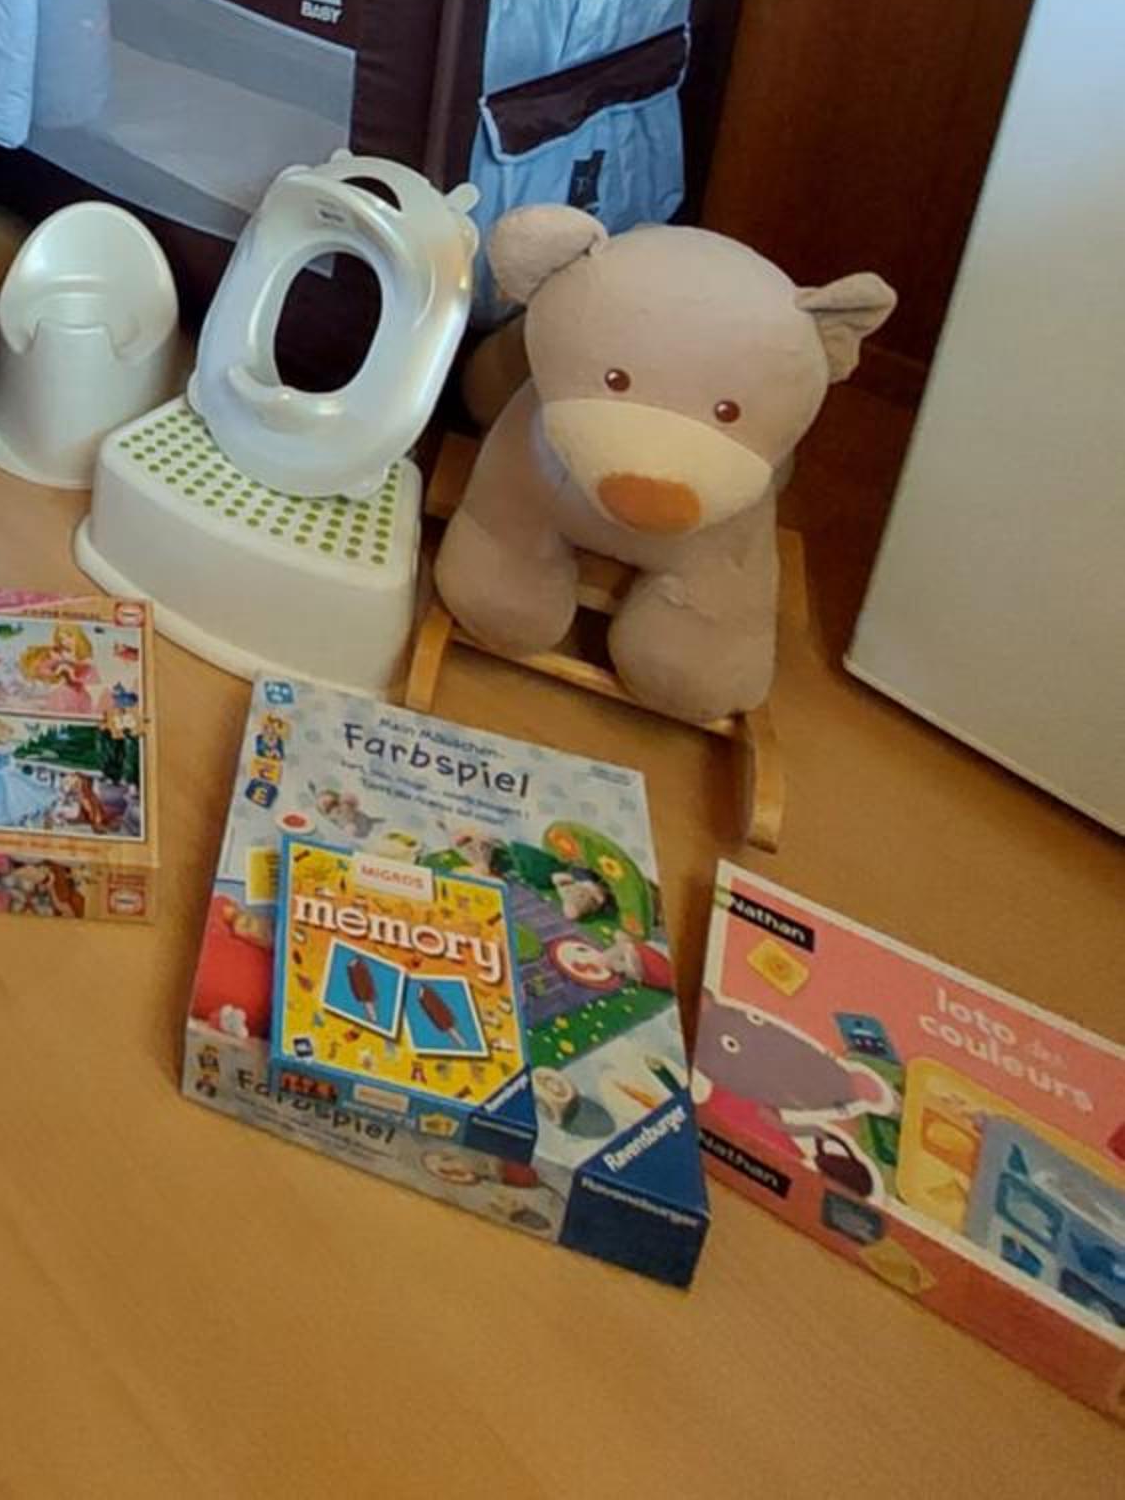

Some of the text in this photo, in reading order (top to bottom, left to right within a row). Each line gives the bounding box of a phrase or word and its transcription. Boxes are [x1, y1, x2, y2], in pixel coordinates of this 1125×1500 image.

[344, 723, 530, 798] Farbspiel
[361, 864, 425, 890] MIGROS
[295, 894, 502, 983] memory
[730, 896, 806, 943] Nathan
[937, 987, 1017, 1046] loto
[919, 1014, 1095, 1113] couleurs
[601, 1104, 687, 1172] Ravensburger
